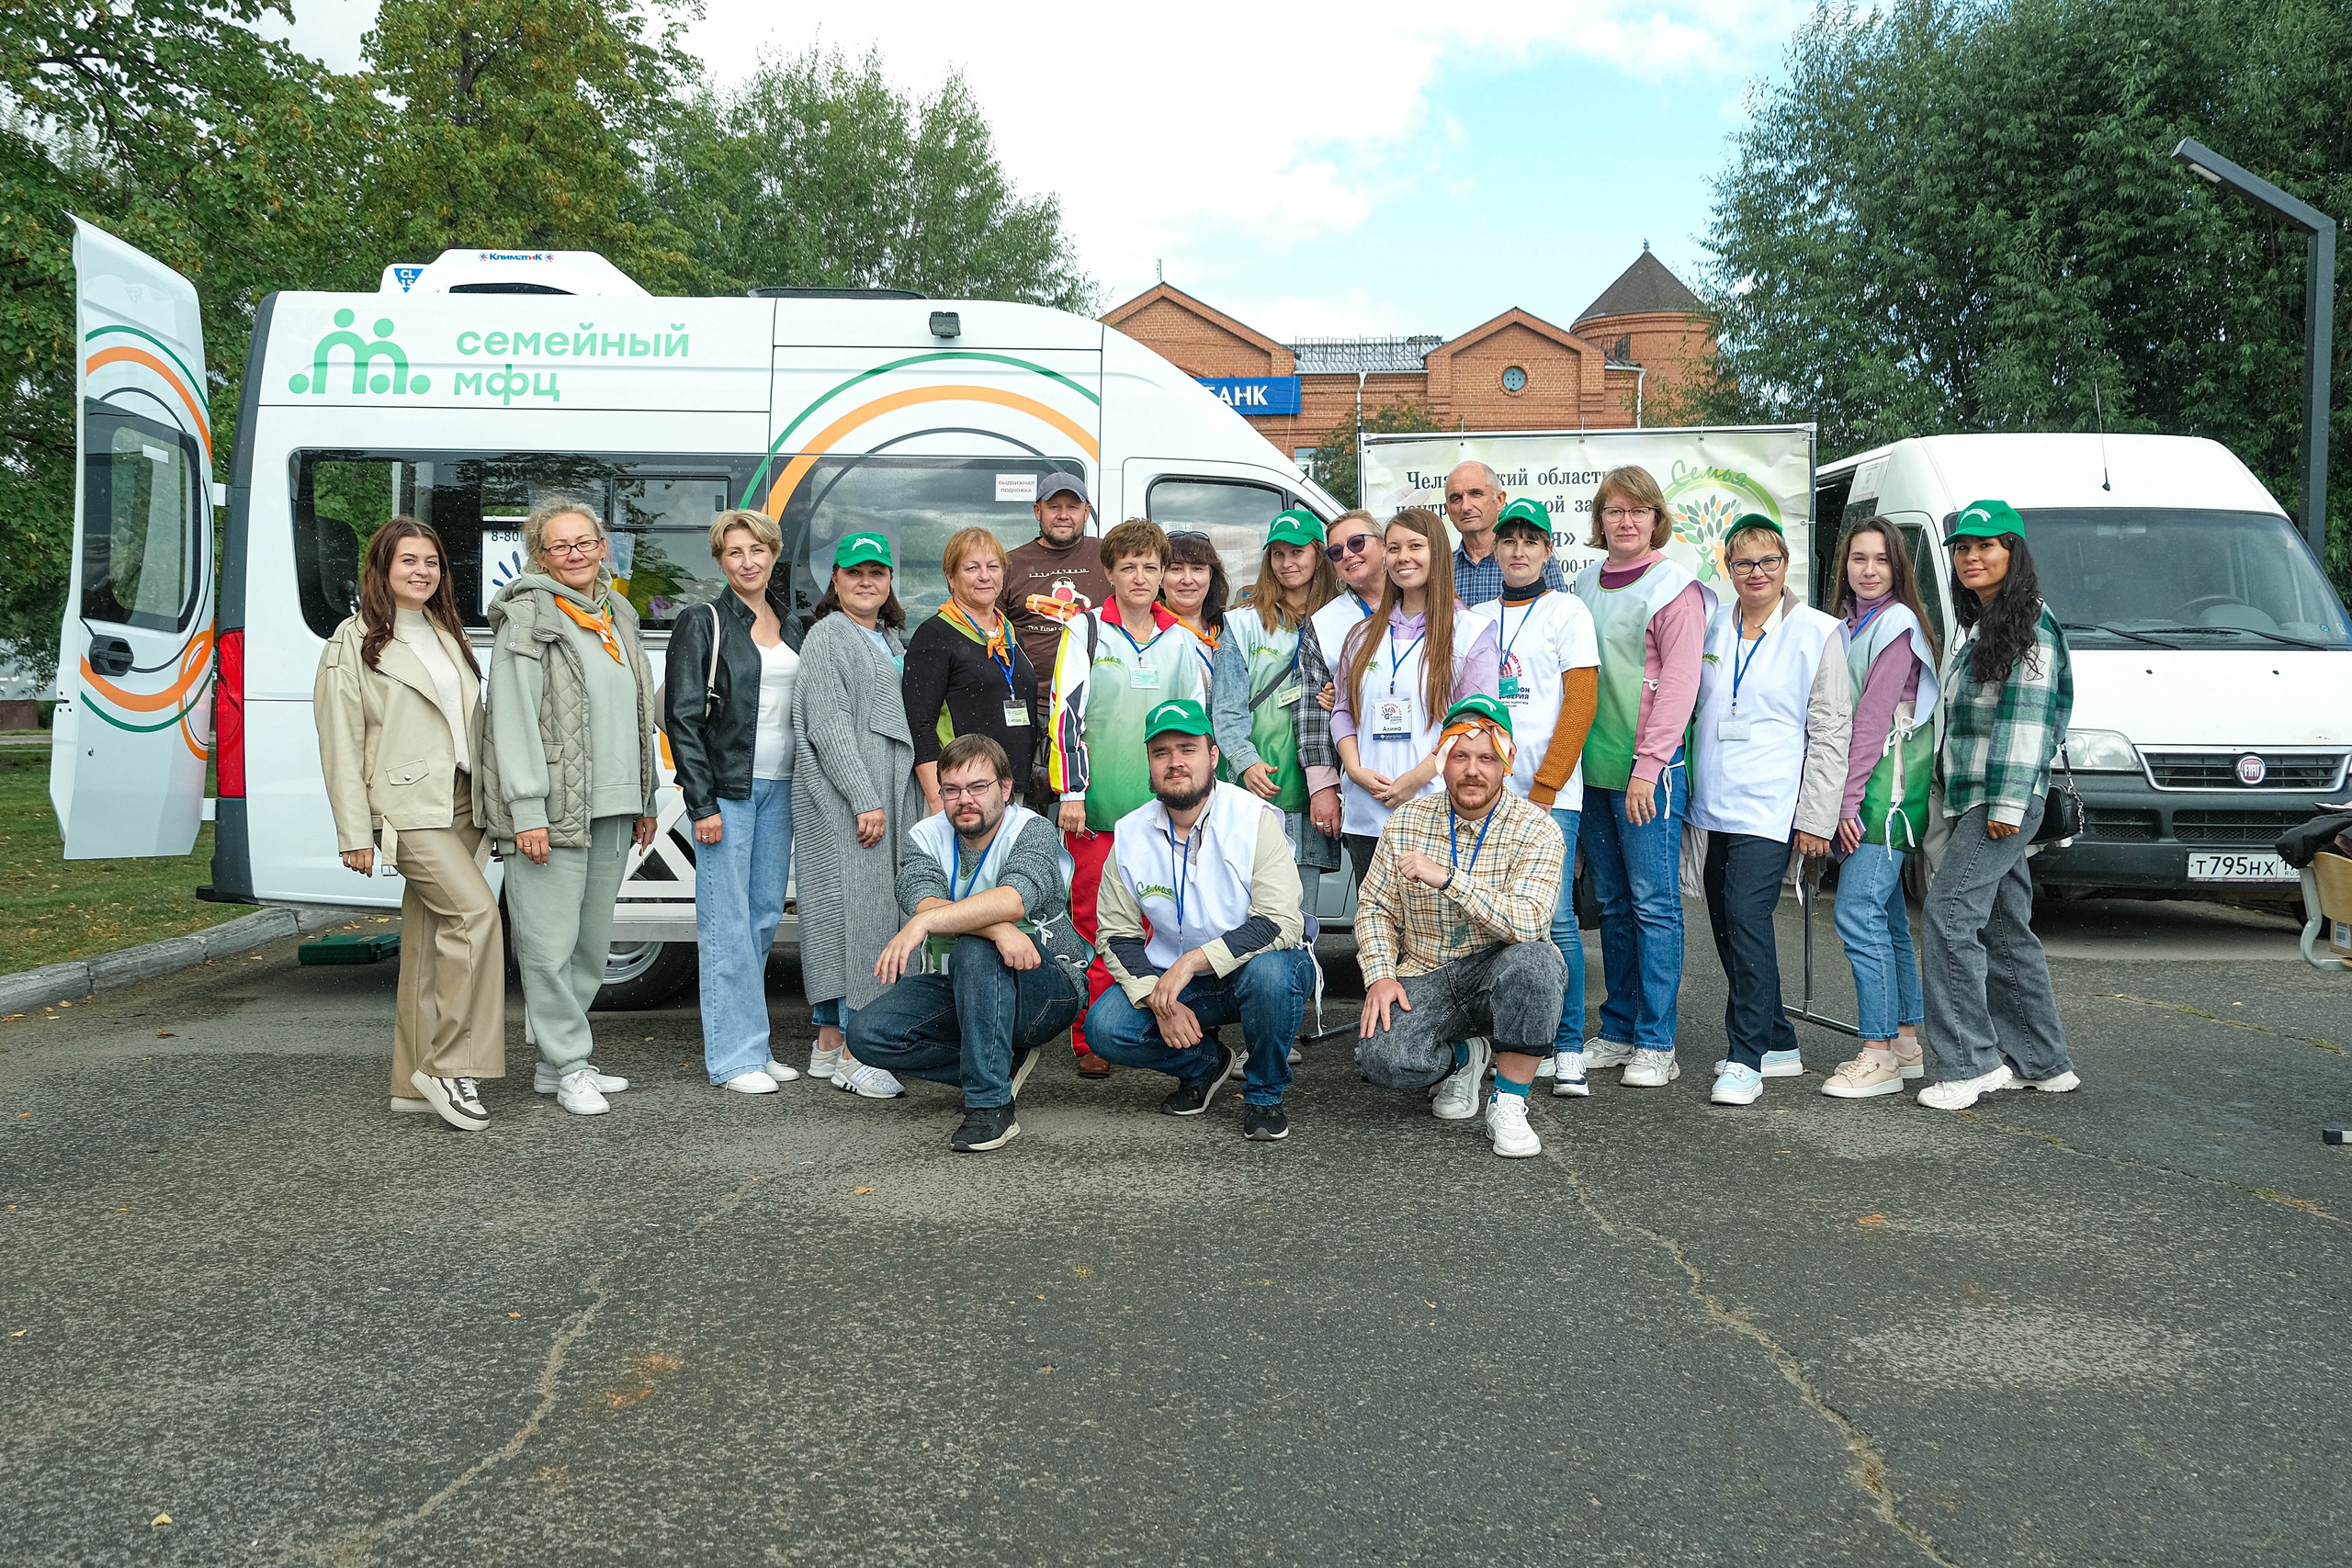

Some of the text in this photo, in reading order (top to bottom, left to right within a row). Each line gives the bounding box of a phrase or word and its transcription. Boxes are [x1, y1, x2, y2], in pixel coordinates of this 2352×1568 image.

[400, 269, 416, 278] CL
[456, 322, 690, 357] семейный
[453, 364, 560, 406] мфц
[1204, 386, 1269, 406] АНК
[1671, 459, 1747, 488] Семья
[2244, 764, 2261, 777] FIAT
